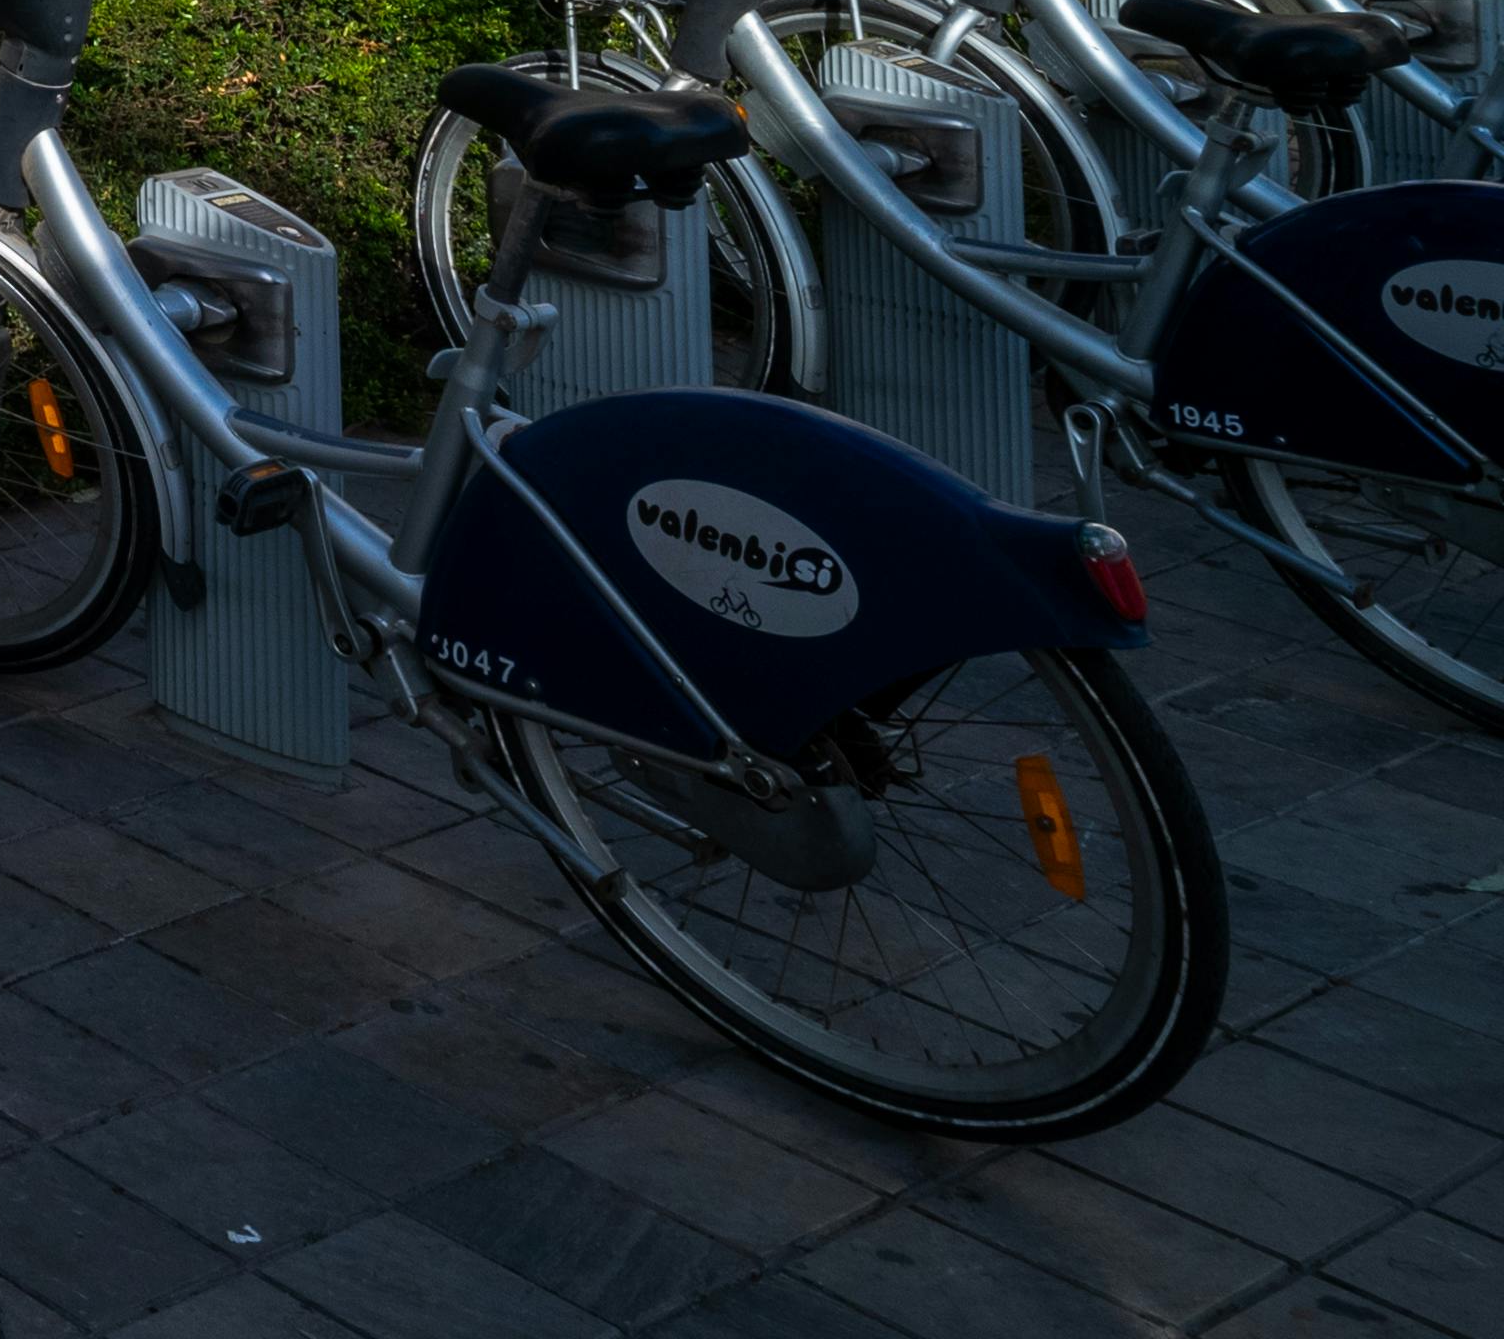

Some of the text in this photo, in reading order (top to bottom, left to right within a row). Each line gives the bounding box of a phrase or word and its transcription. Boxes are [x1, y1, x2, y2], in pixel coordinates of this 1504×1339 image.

[1390, 283, 1504, 321] valen
[1169, 403, 1244, 437] 1945
[637, 498, 838, 590] valenbisi
